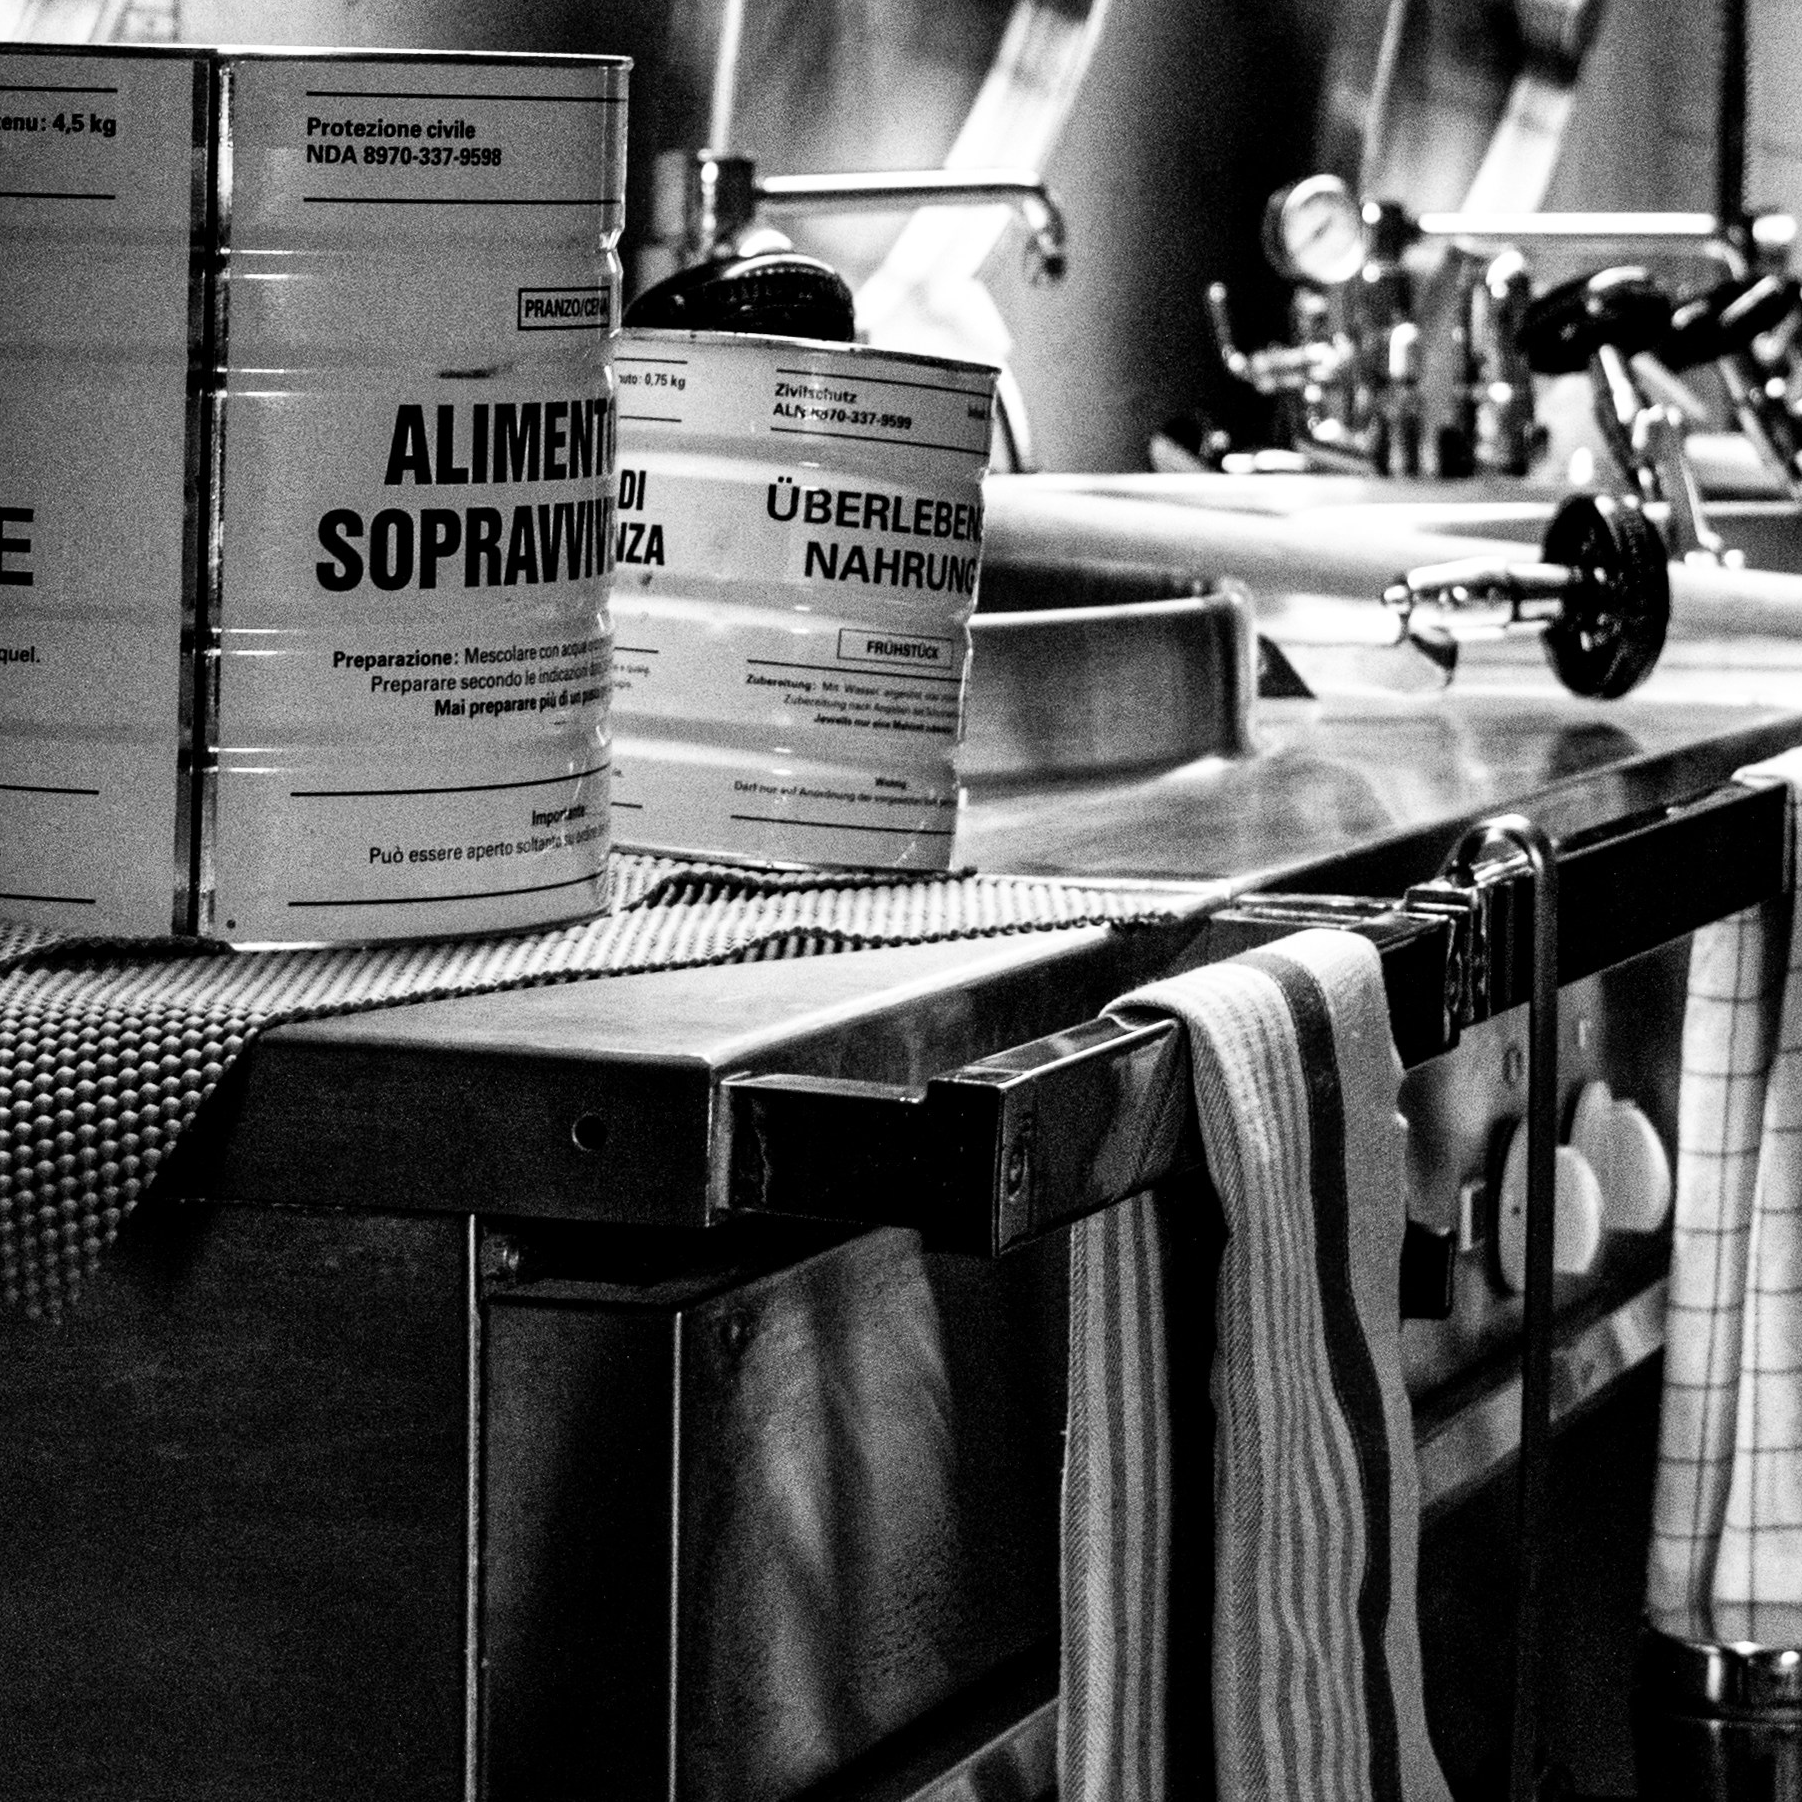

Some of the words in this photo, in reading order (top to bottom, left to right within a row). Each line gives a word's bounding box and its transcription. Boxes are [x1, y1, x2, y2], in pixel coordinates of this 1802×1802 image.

[53, 114, 84, 134] 4,5
[90, 114, 117, 138] kg
[307, 117, 421, 139] Protezione
[427, 119, 476, 140] civile
[307, 145, 357, 166] NDA
[363, 146, 502, 166] 8970-337-9598
[670, 374, 686, 390] kg
[618, 469, 646, 510] DI
[804, 541, 977, 596] NAHRUNG
[333, 649, 458, 672] Preparazione:
[464, 644, 537, 665] Mescolare
[866, 639, 939, 660] FRÜHSTÜCK
[371, 675, 457, 696] Preparare
[460, 670, 521, 691] secondo
[525, 671, 536, 687] le
[435, 699, 466, 717] Mai
[469, 698, 537, 719] preparare
[369, 845, 404, 864] Può
[408, 845, 462, 863] essere
[466, 841, 513, 862] aperto
